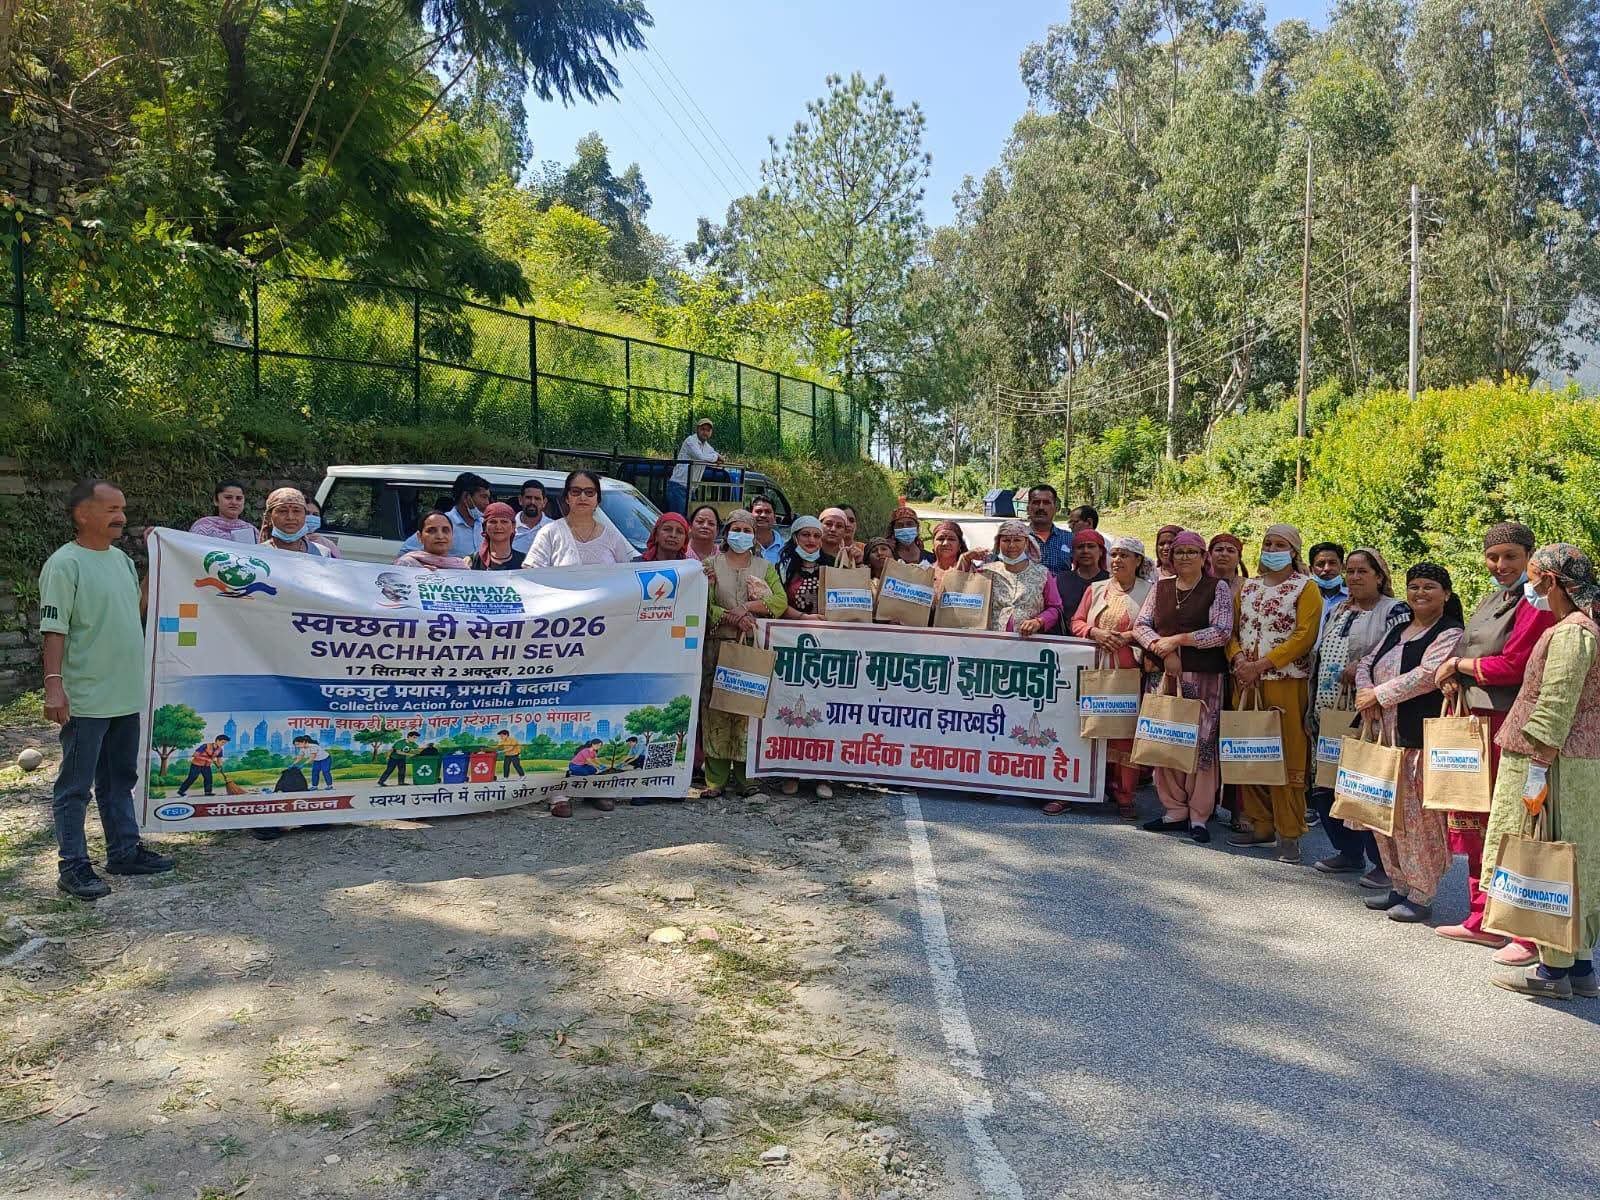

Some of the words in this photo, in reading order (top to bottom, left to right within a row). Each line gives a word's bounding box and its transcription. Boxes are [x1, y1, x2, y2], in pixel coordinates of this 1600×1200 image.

[418, 583, 517, 595] SWACHHATA
[420, 592, 435, 601] HI
[441, 593, 481, 603] SEVA
[483, 594, 522, 603] 2026
[640, 611, 673, 620] SJVN
[291, 611, 419, 639] स्वच्छता
[427, 613, 458, 642] ही
[466, 615, 525, 640] सेवा
[531, 616, 606, 639] 2026
[310, 640, 484, 661] SWACHHATA
[491, 644, 516, 660] HI
[522, 643, 585, 659] SEVA
[345, 665, 366, 676] 17
[371, 663, 427, 677] सितम्बर
[431, 665, 444, 677] से
[448, 667, 458, 677] 2
[517, 665, 554, 675] 2026
[773, 633, 862, 689] महिला
[865, 650, 955, 695] मण्डल
[320, 684, 391, 701] एकजुट
[394, 684, 451, 699] प्रयास,
[457, 681, 512, 697] प्रभावी
[516, 680, 572, 695] बदलाव
[329, 701, 399, 711] Collective
[402, 700, 447, 711] Action
[450, 700, 469, 709] for
[472, 698, 514, 708] Visible
[517, 696, 560, 706] Impact
[826, 701, 863, 726] ग्राम
[867, 697, 935, 730] पंचायत
[765, 736, 835, 763] आपका
[840, 732, 905, 767] हार्दिक
[909, 744, 982, 774] स्वागत
[987, 750, 1046, 780] करता
[369, 794, 407, 807] स्वस्थ
[410, 787, 453, 805] उन्नति
[458, 787, 469, 802] में
[511, 785, 537, 799] और
[571, 778, 588, 789] को
[592, 776, 638, 789] भागीदार
[641, 775, 675, 786] बनाना
[1518, 888, 1569, 905] FOUNDATION
